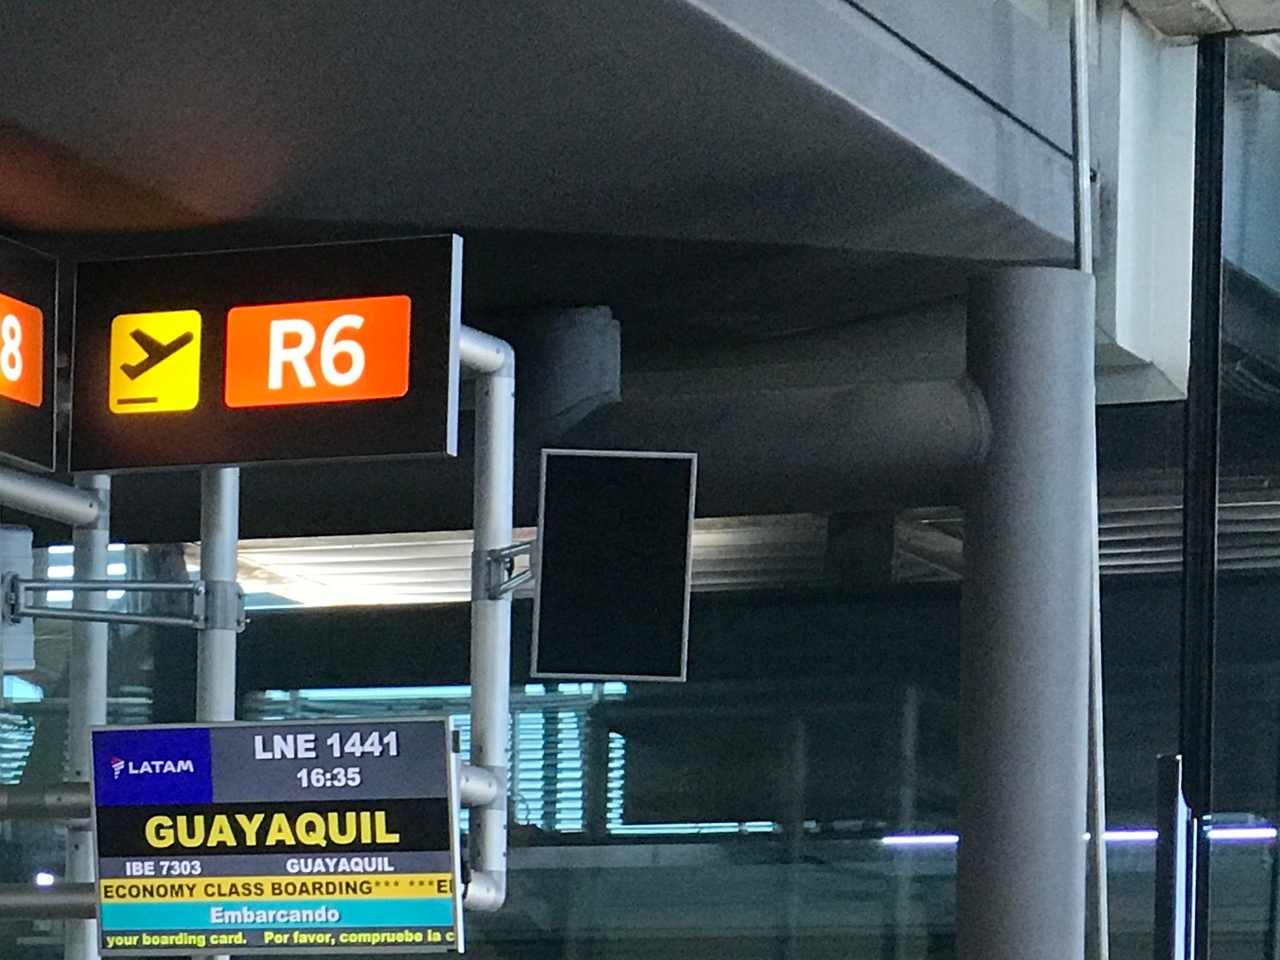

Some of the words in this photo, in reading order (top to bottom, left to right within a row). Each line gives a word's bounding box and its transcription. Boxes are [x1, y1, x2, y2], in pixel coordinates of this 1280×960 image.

[268, 314, 366, 390] R6
[254, 731, 316, 760] LNE
[326, 730, 399, 758] 1441
[128, 760, 194, 775] LATAM
[296, 767, 362, 788] 16:35
[145, 810, 401, 848] GUAYAQUIL
[125, 861, 156, 876] IBE
[159, 860, 202, 876] 7303
[285, 857, 395, 874] GUAYAQUIL
[103, 883, 197, 899] ECONOMY
[203, 882, 265, 898] CLASS
[210, 905, 341, 924] Embarcando
[106, 935, 139, 948] your
[142, 933, 207, 948] boarding
[210, 932, 247, 945] card.
[264, 931, 289, 944] Por
[293, 930, 336, 945] favor,
[427, 928, 442, 942] la
